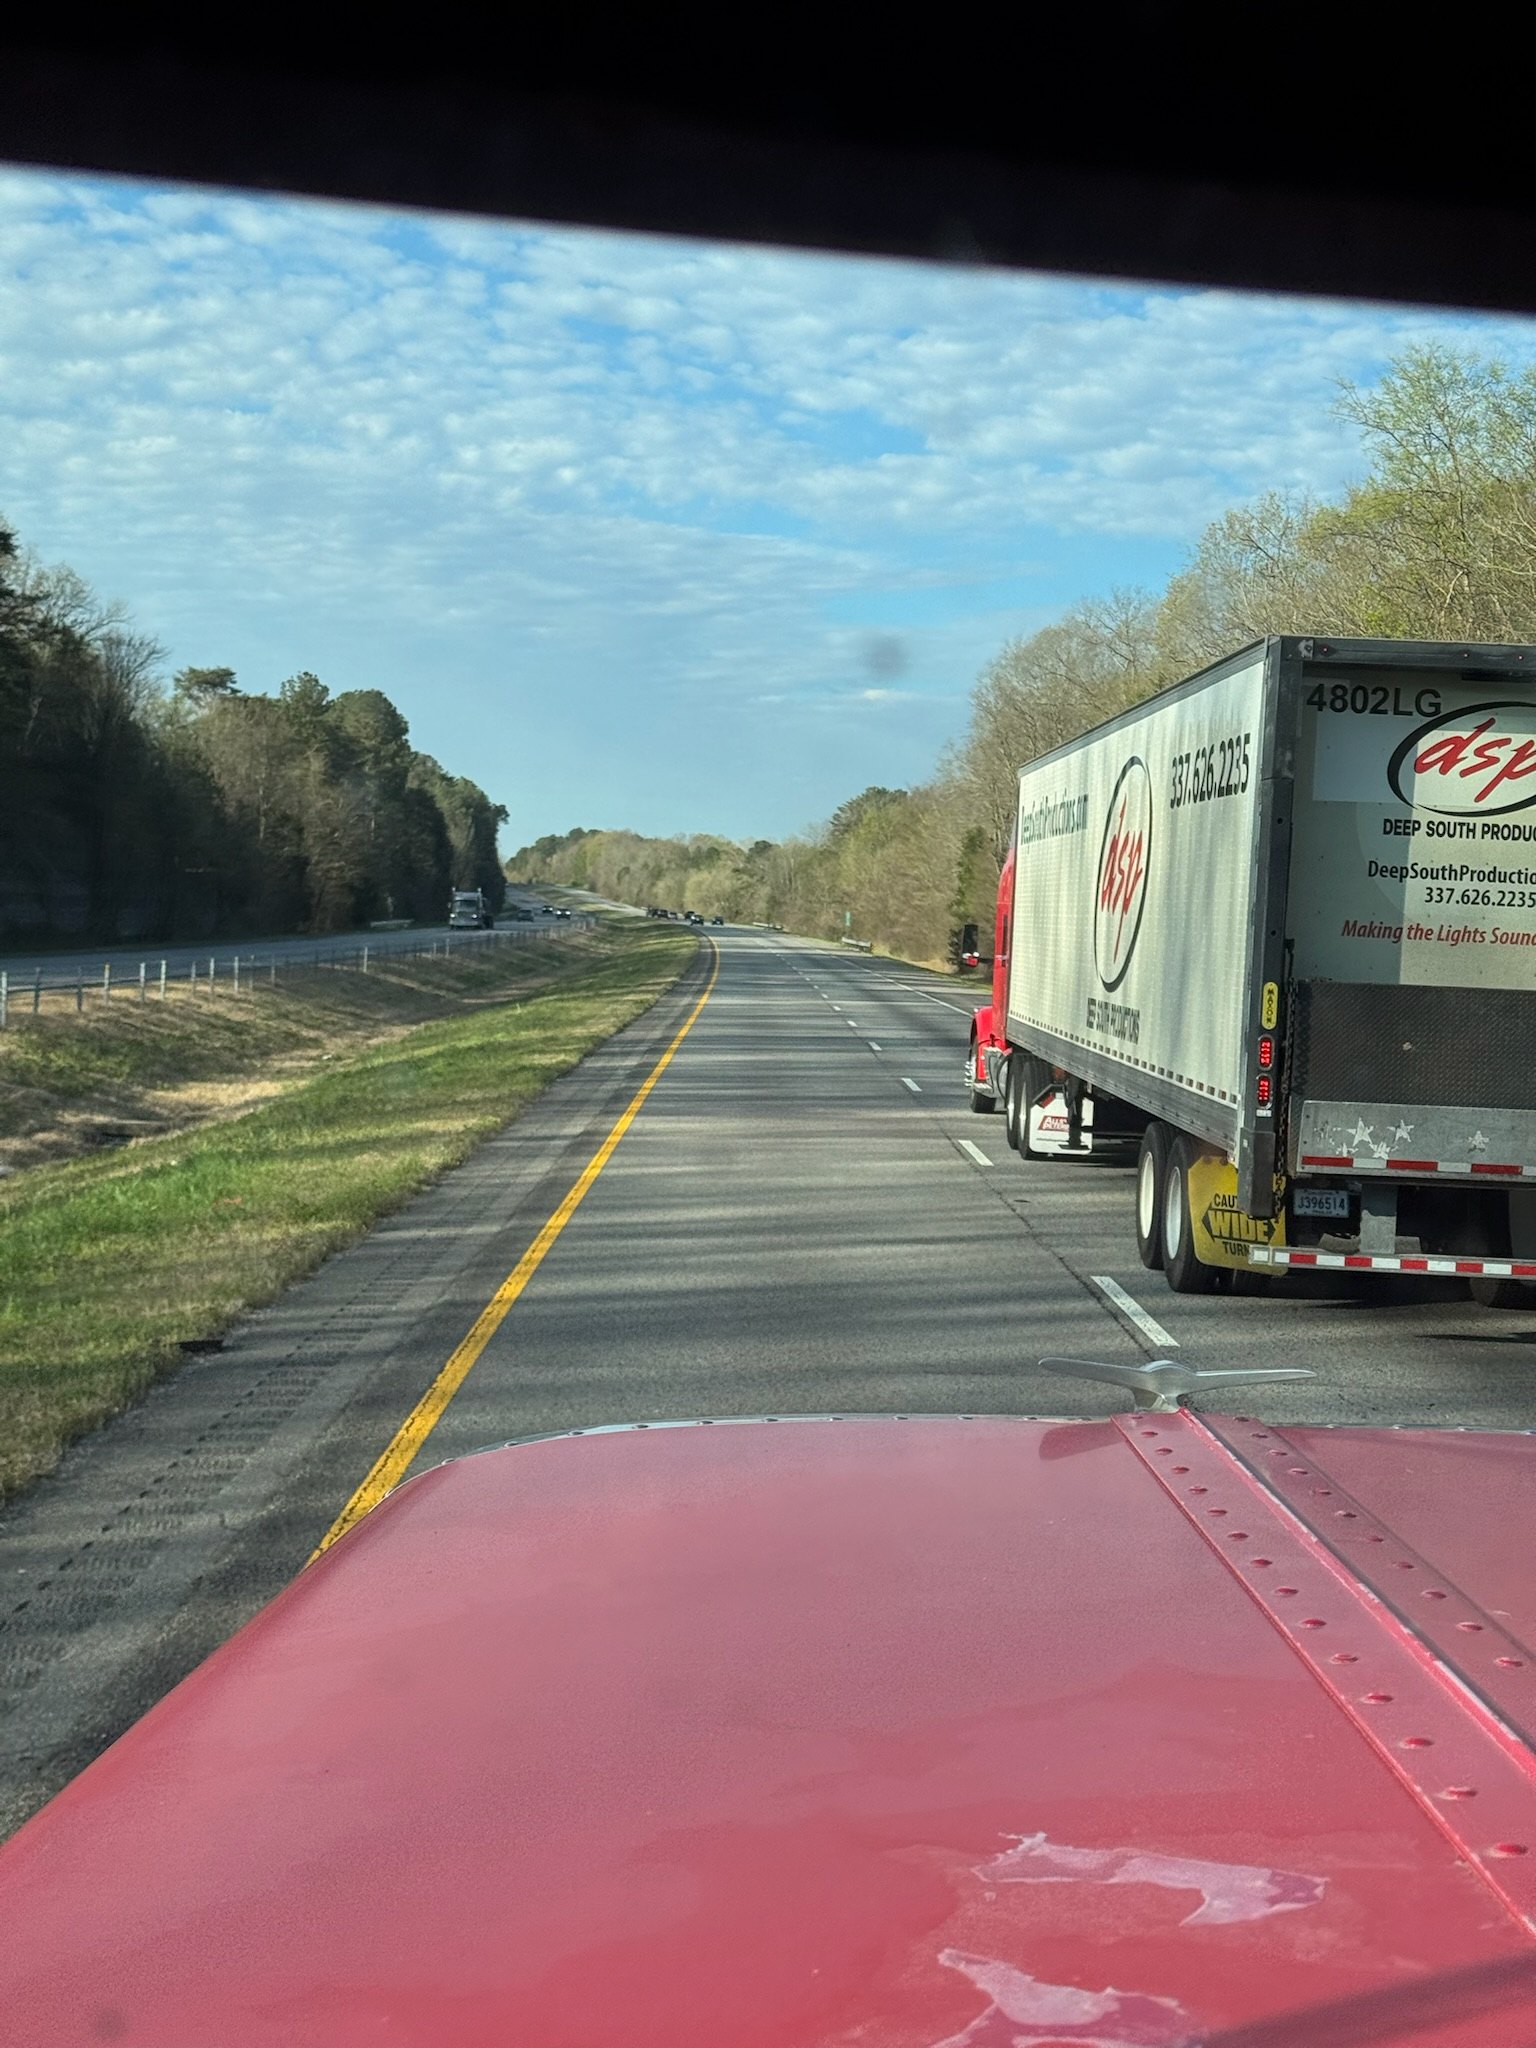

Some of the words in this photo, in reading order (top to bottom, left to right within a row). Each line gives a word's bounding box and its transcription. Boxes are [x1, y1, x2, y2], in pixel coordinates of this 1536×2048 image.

[1306, 683, 1442, 718] 4802LG
[1170, 732, 1251, 810] 337.626.2235
[1413, 717, 1536, 803] dsp
[1383, 818, 1422, 837] DEEP
[1425, 820, 1477, 840] SOUTH
[1424, 886, 1536, 908] 337.626.2235
[1341, 920, 1404, 944] Making
[1406, 923, 1434, 941] the
[1436, 925, 1486, 947] Lights
[1213, 1192, 1238, 1209] CAU
[1297, 1195, 1346, 1211] J396514
[1208, 1209, 1270, 1243] WIDE
